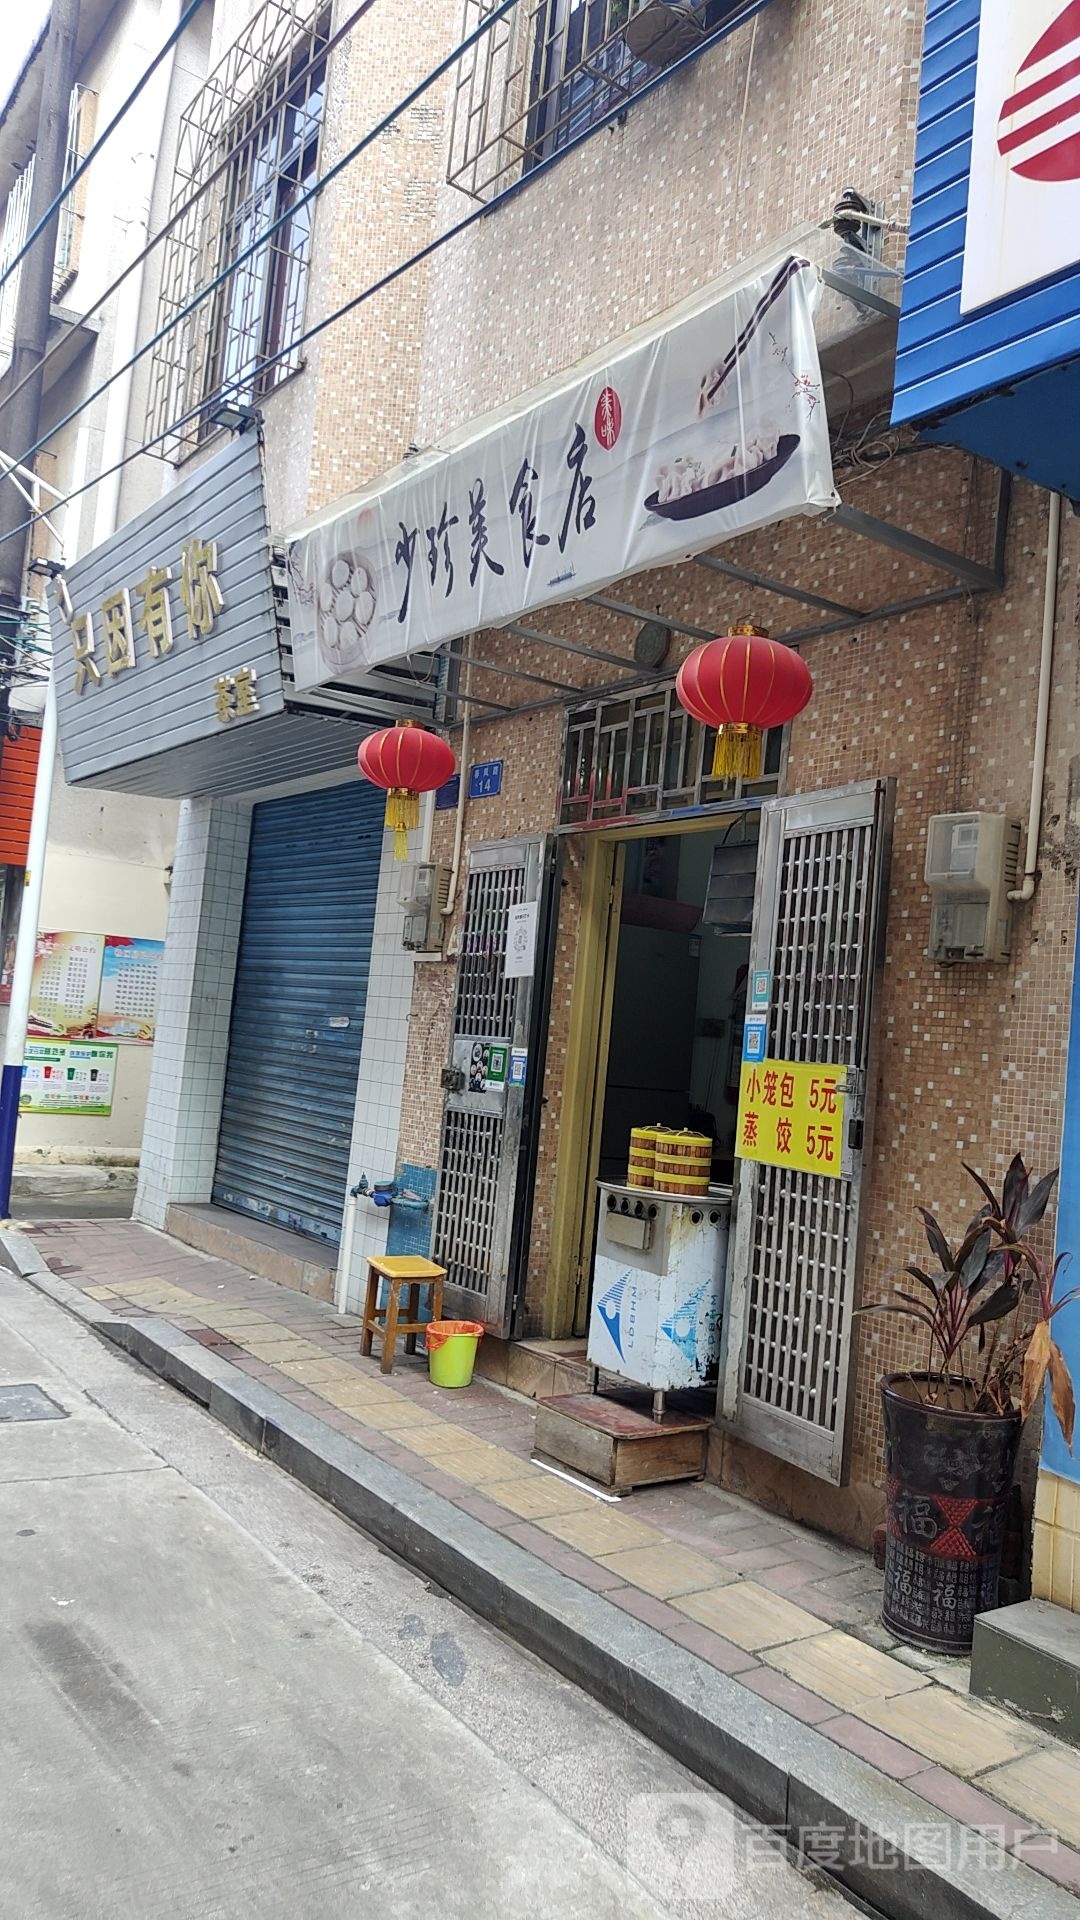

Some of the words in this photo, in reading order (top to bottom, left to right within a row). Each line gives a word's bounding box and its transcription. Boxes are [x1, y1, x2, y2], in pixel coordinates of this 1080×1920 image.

[71, 538, 225, 695] 只因有你
[479, 778, 491, 793] 14
[745, 1068, 795, 1108] 小笼包
[809, 1078, 838, 1114] 5元
[806, 1125, 834, 1161] 5元
[932, 1581, 957, 1610] 福
